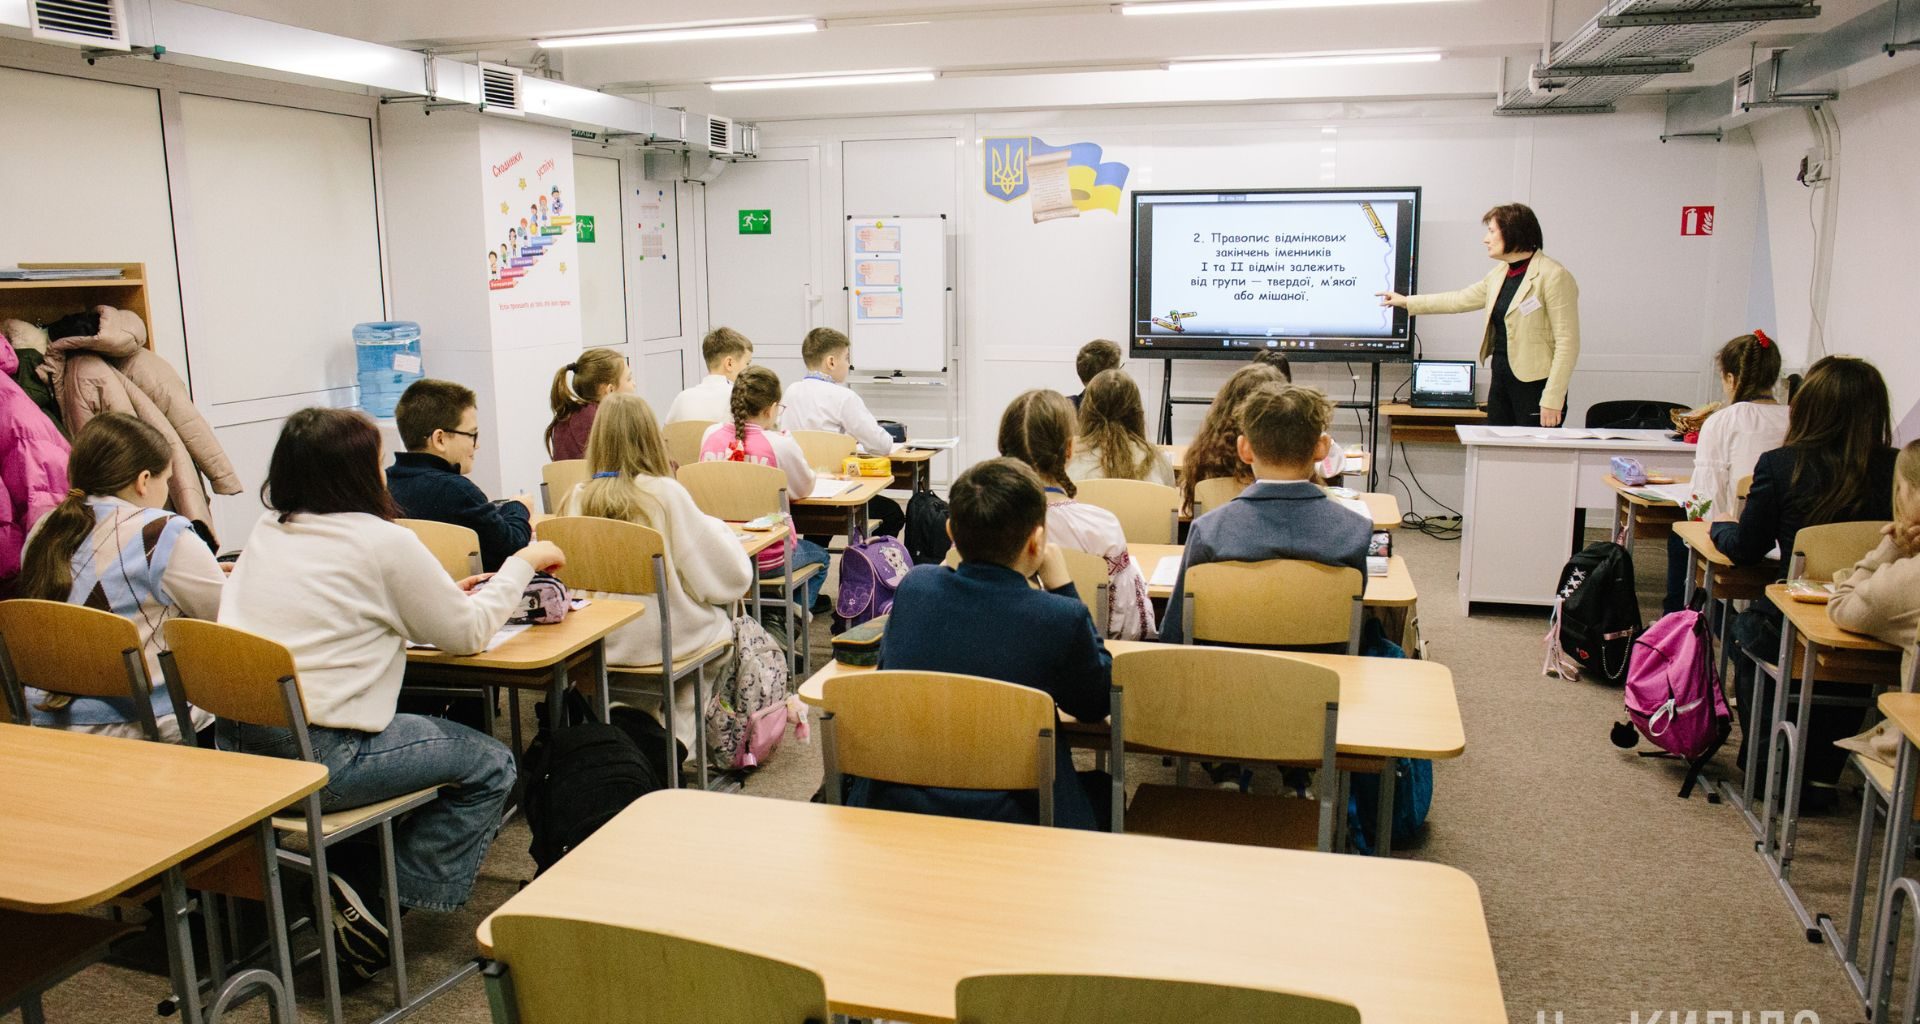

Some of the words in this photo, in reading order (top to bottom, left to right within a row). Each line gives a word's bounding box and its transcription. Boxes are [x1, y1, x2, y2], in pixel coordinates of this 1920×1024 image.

[492, 151, 524, 178] Сходинки
[1193, 232, 1205, 244] 2.
[1211, 232, 1270, 246] Правопис
[1274, 232, 1347, 244] відмінкових
[1215, 247, 1270, 258] закінчень
[1274, 247, 1332, 258] іменників
[1213, 263, 1226, 273] та
[1248, 261, 1285, 273] відмін
[1290, 263, 1346, 273] залежить
[1190, 276, 1208, 287] від
[1212, 278, 1247, 289] групи
[1266, 276, 1314, 289] твердої,
[1233, 290, 1255, 301] або
[1258, 290, 1309, 302] мішаної.
